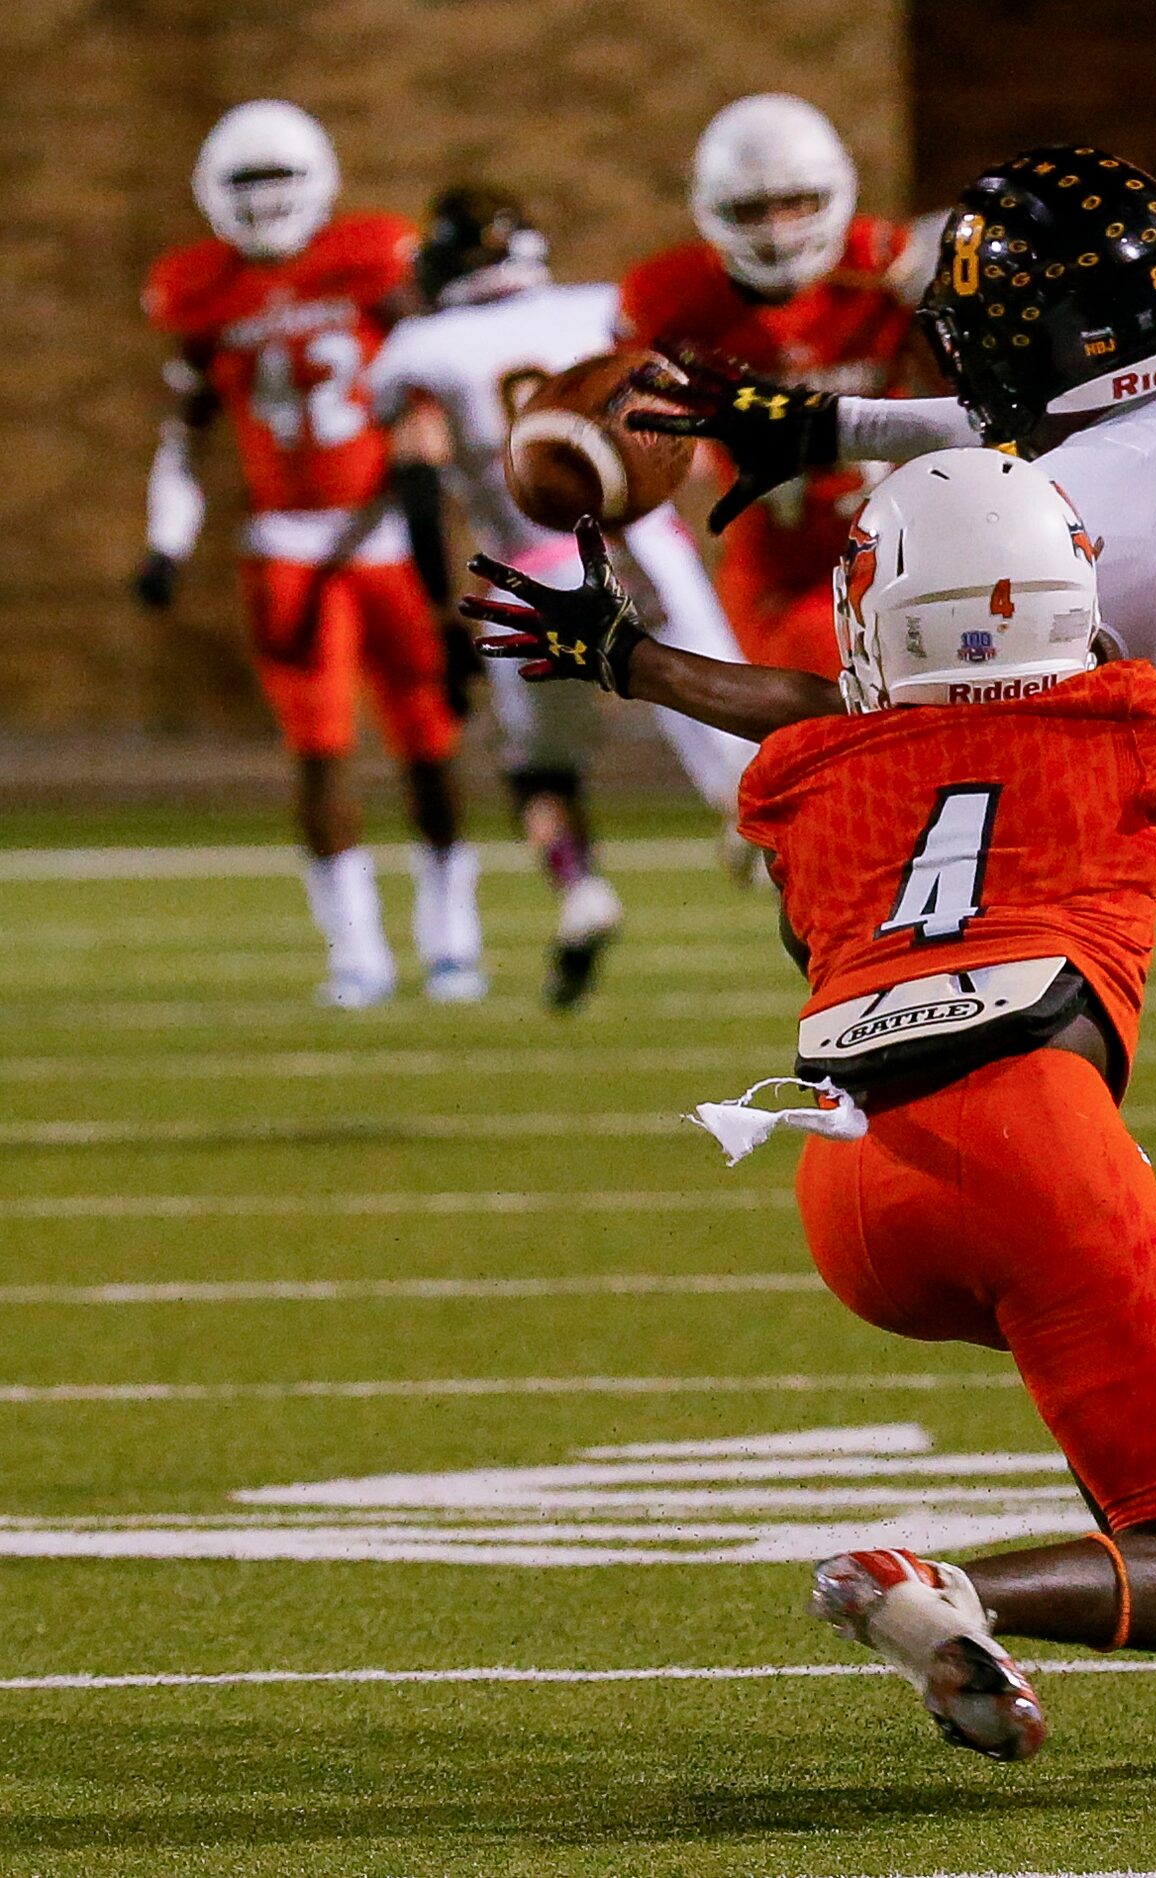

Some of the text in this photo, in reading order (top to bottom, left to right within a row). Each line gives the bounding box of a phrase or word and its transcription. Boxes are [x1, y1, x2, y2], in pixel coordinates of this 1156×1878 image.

[952, 211, 984, 296] 8
[990, 578, 1015, 619] 4
[949, 674, 1058, 704] Riddell
[874, 780, 1004, 946] 4
[850, 1001, 971, 1042] BATTLE
